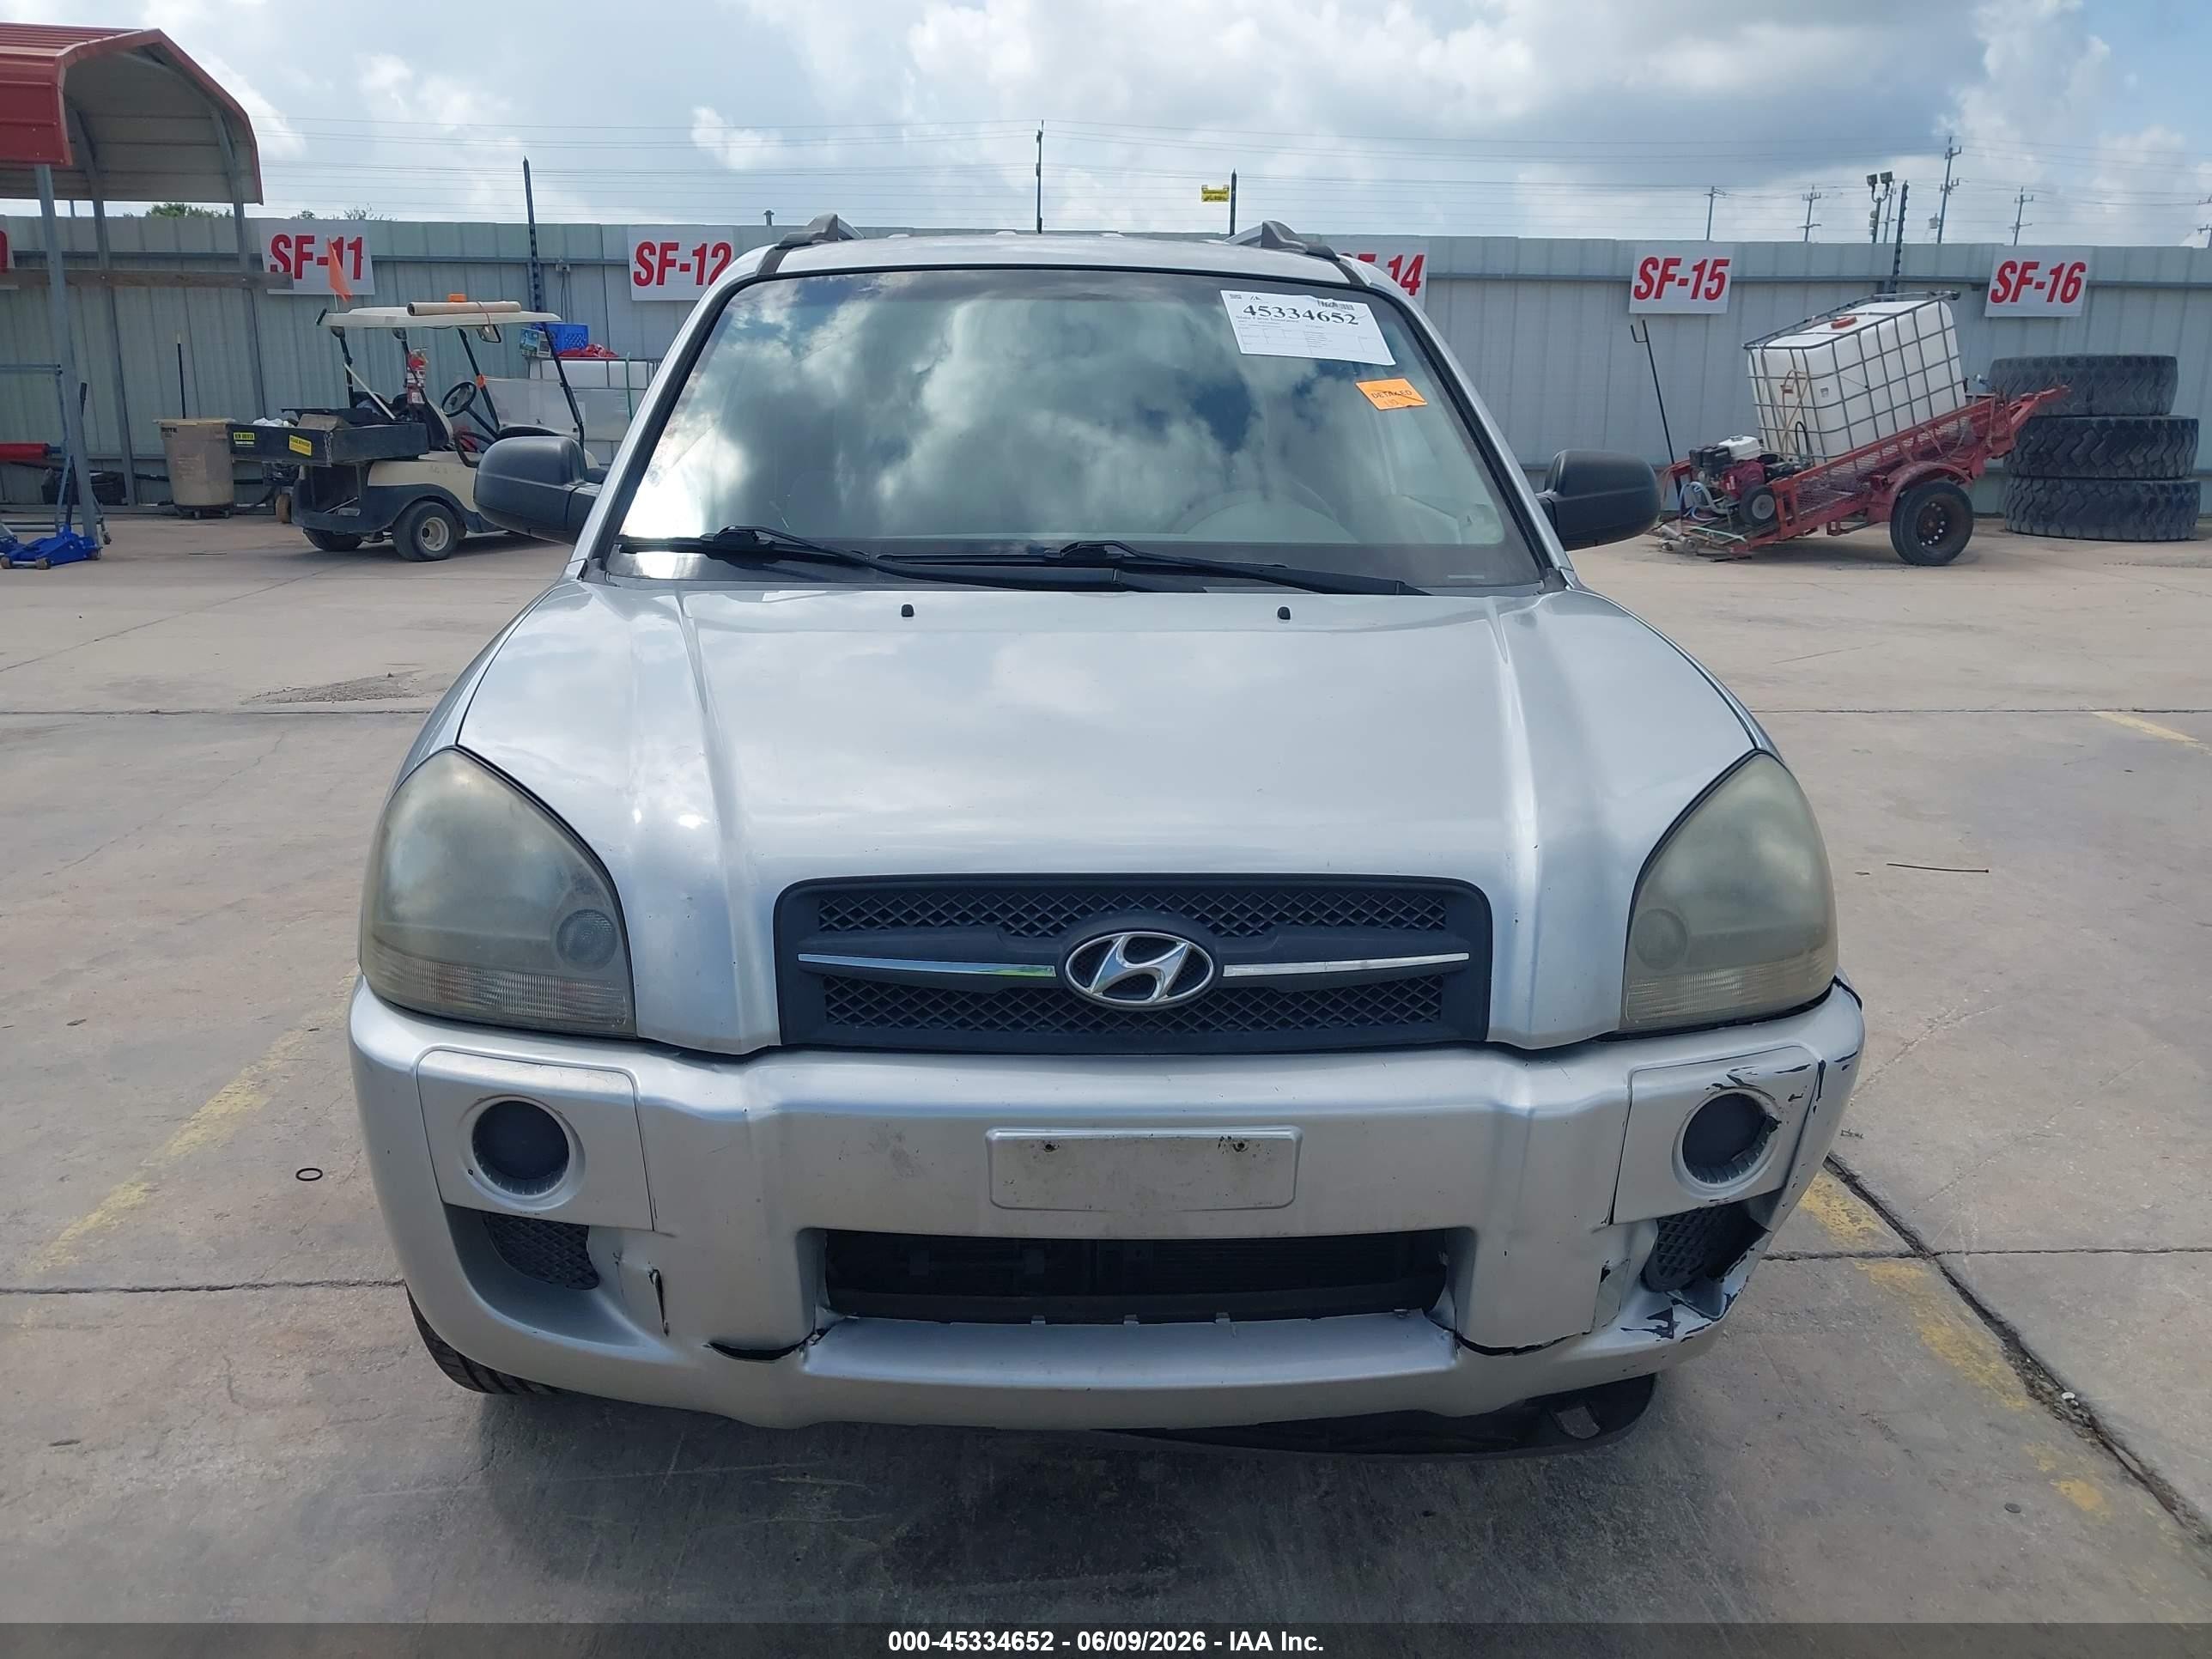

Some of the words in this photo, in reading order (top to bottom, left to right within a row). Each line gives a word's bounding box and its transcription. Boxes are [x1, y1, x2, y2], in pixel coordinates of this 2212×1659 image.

[270, 234, 363, 280] SF-11
[633, 241, 732, 287] SF-12
[1633, 257, 1731, 301] SF-15
[1990, 260, 2087, 303] SF-16
[1243, 304, 1359, 325] 45334652
